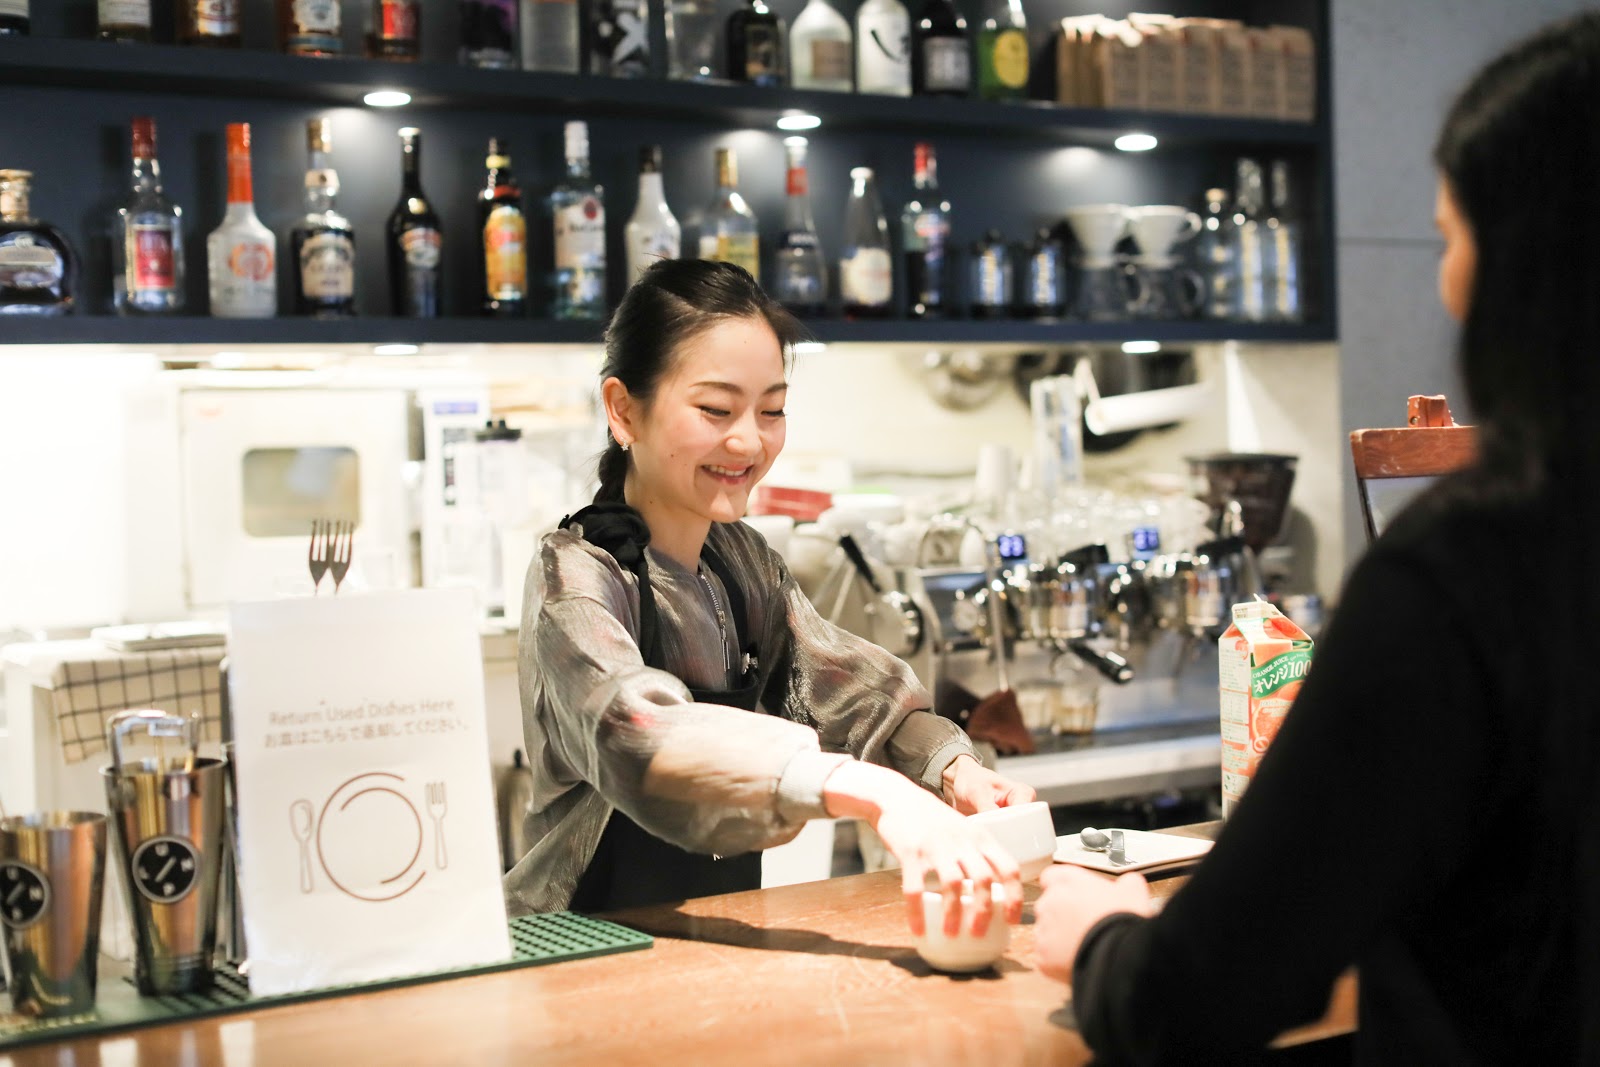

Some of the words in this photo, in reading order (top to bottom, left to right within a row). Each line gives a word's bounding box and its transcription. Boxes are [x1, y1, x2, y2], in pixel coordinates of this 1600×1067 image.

[1252, 664, 1274, 679] ORANGE
[1273, 655, 1289, 668] JUICE
[269, 709, 322, 726] Return
[325, 703, 364, 722] Used
[368, 700, 416, 718] Dishes
[420, 697, 455, 714] Here
